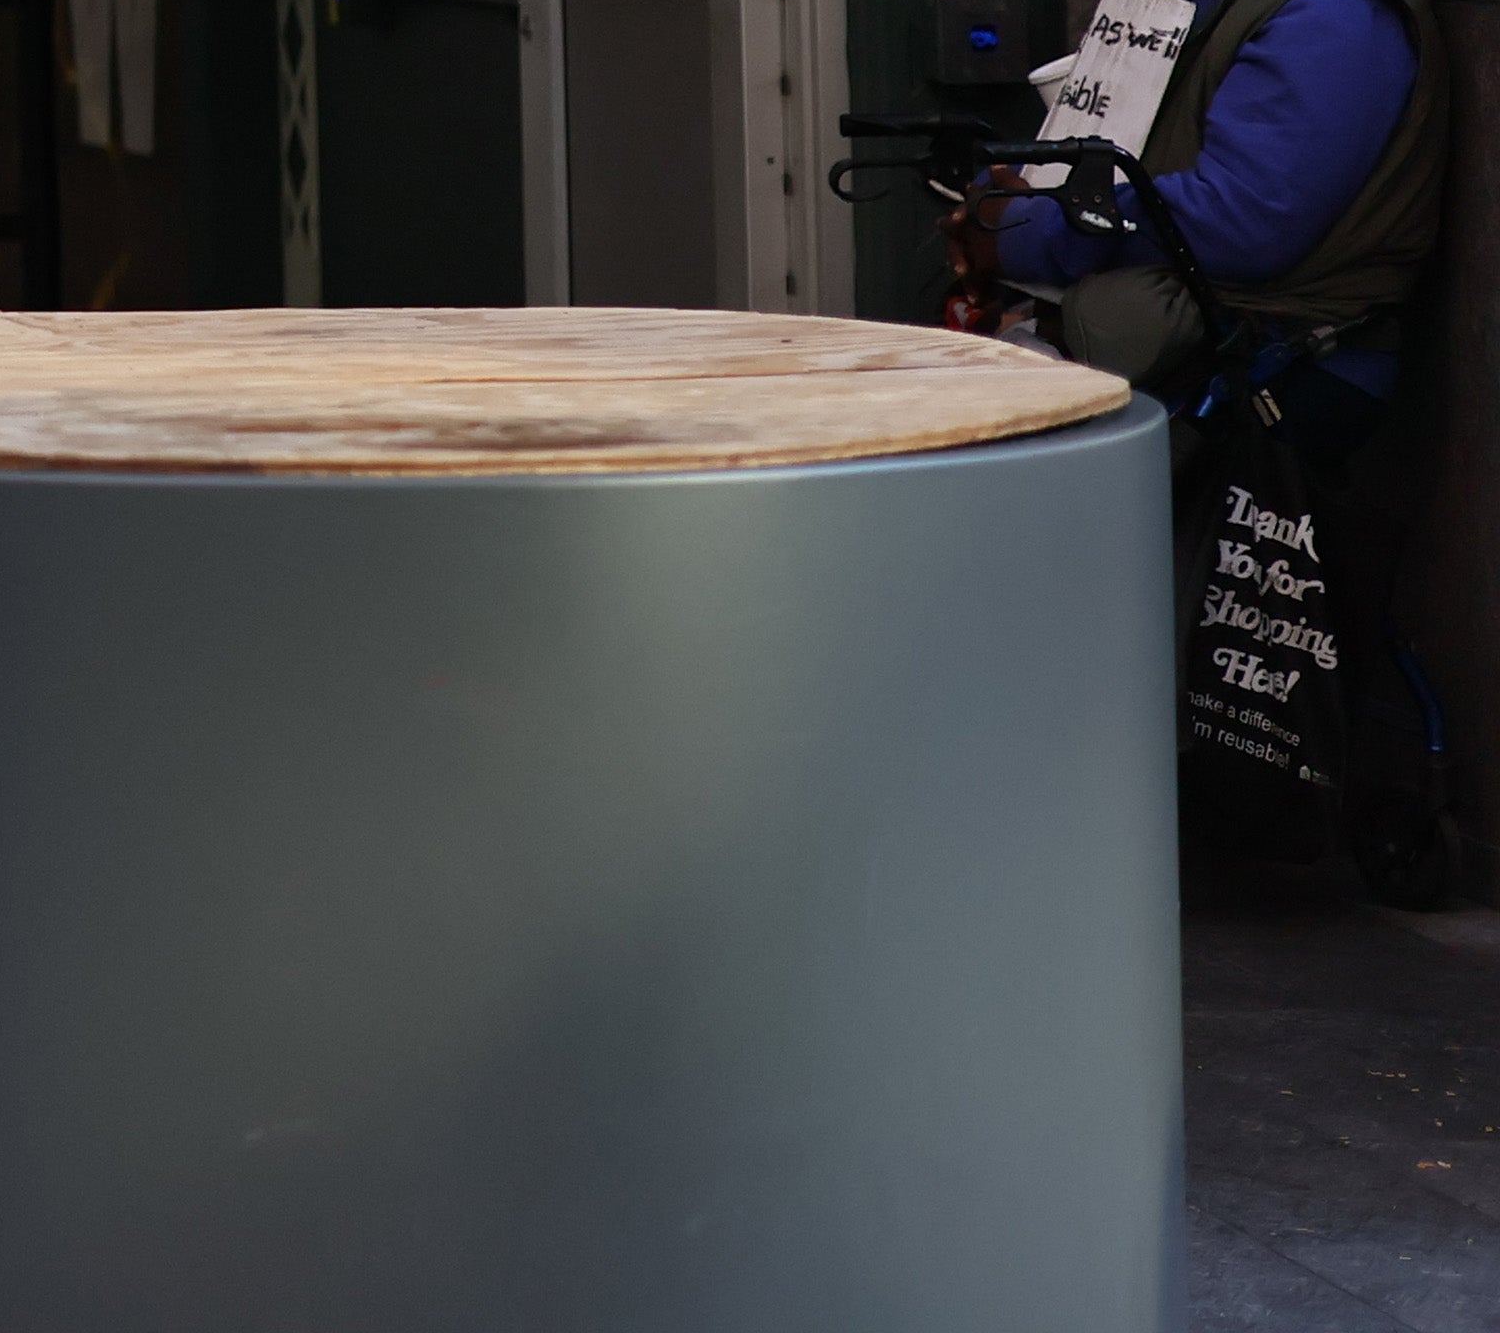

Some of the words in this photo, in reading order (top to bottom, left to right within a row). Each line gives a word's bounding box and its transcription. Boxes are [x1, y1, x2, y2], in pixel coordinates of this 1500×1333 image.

[1090, 14, 1123, 46] AS
[1199, 583, 1340, 670] Shopping
[1213, 647, 1301, 704] Hee!
[1191, 714, 1212, 739] 'm
[1217, 728, 1291, 770] reusabe!
[1227, 704, 1236, 719] a
[1239, 707, 1301, 747] diffence
